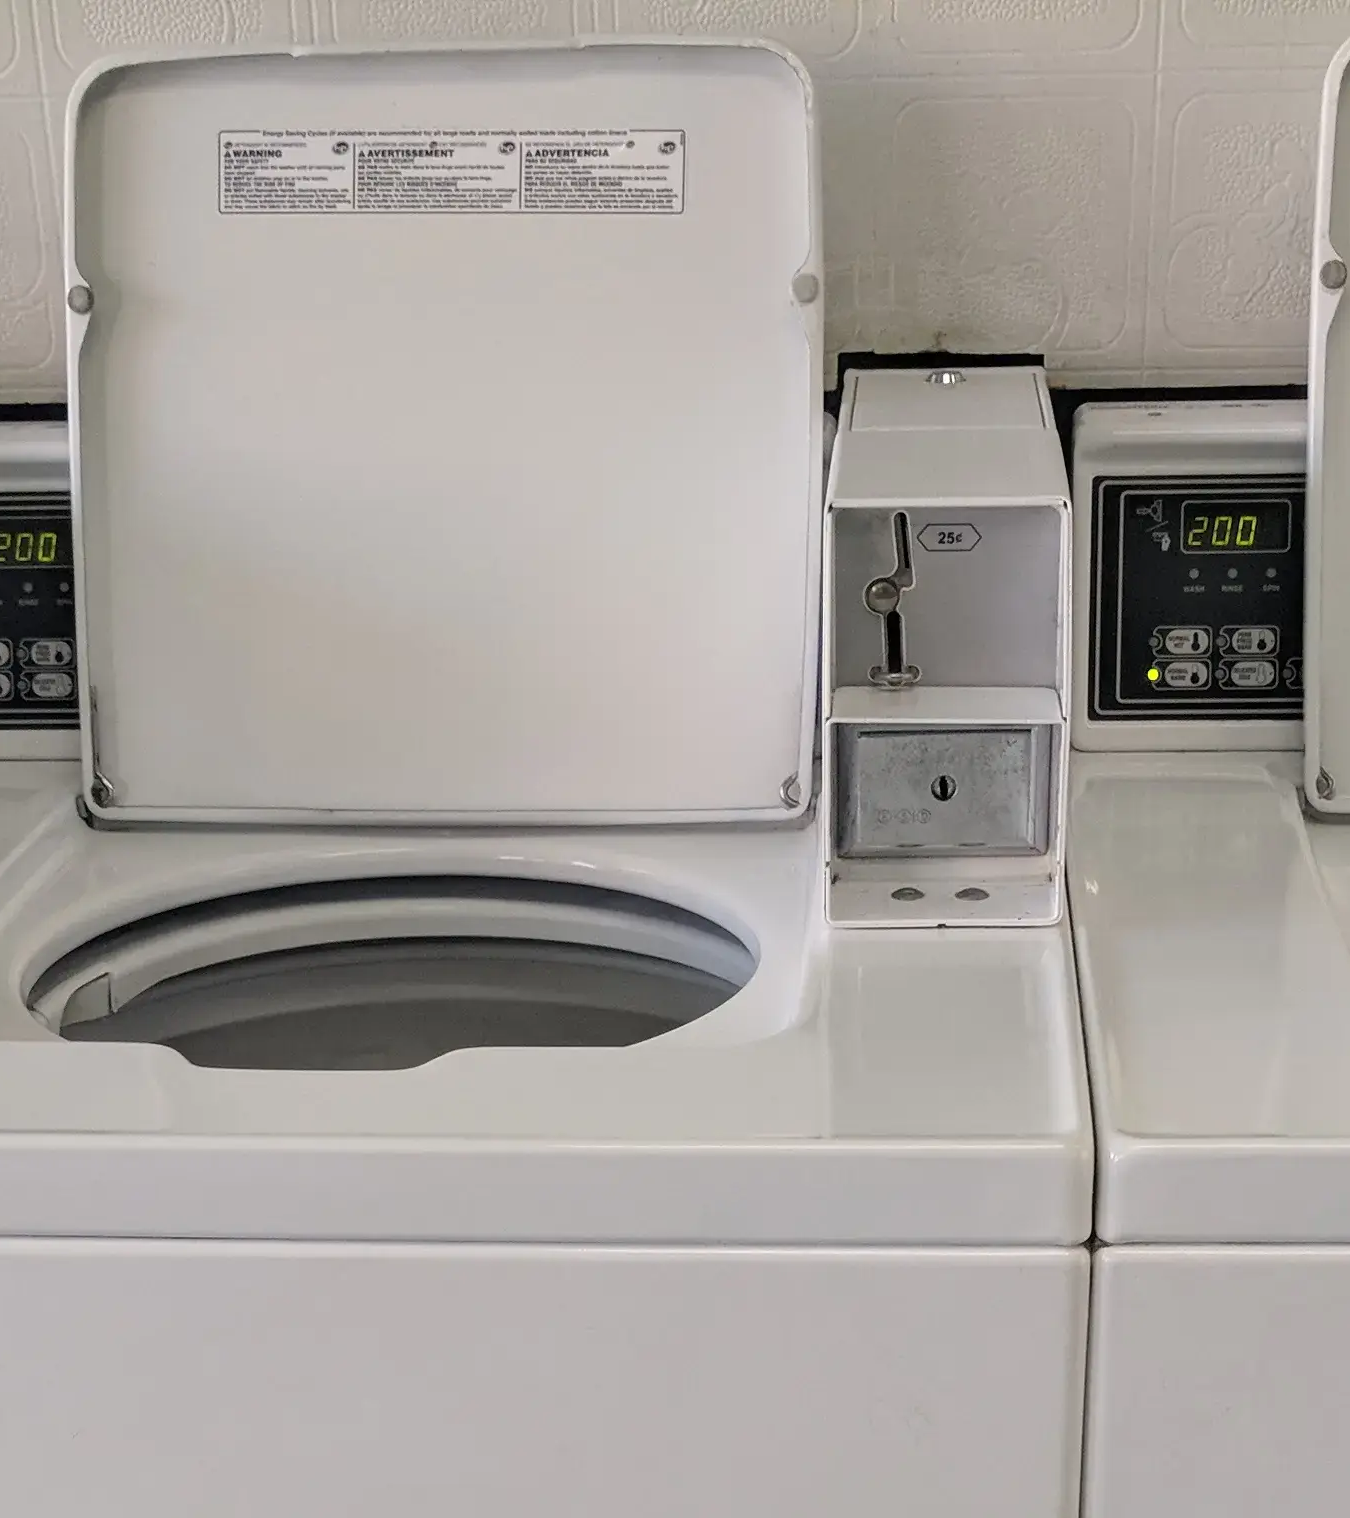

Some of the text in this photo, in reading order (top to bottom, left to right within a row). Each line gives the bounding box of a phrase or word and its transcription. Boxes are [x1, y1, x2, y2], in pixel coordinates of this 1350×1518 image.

[233, 149, 283, 158] WARNING
[367, 149, 455, 157] AVERTISSEMENT
[535, 148, 609, 157] ADVERTENCIA
[1188, 516, 1257, 546] 200
[938, 531, 963, 544] 25¢
[1183, 585, 1206, 593] WASH
[1221, 584, 1244, 592] RINSE
[1262, 584, 1280, 592] SPIN
